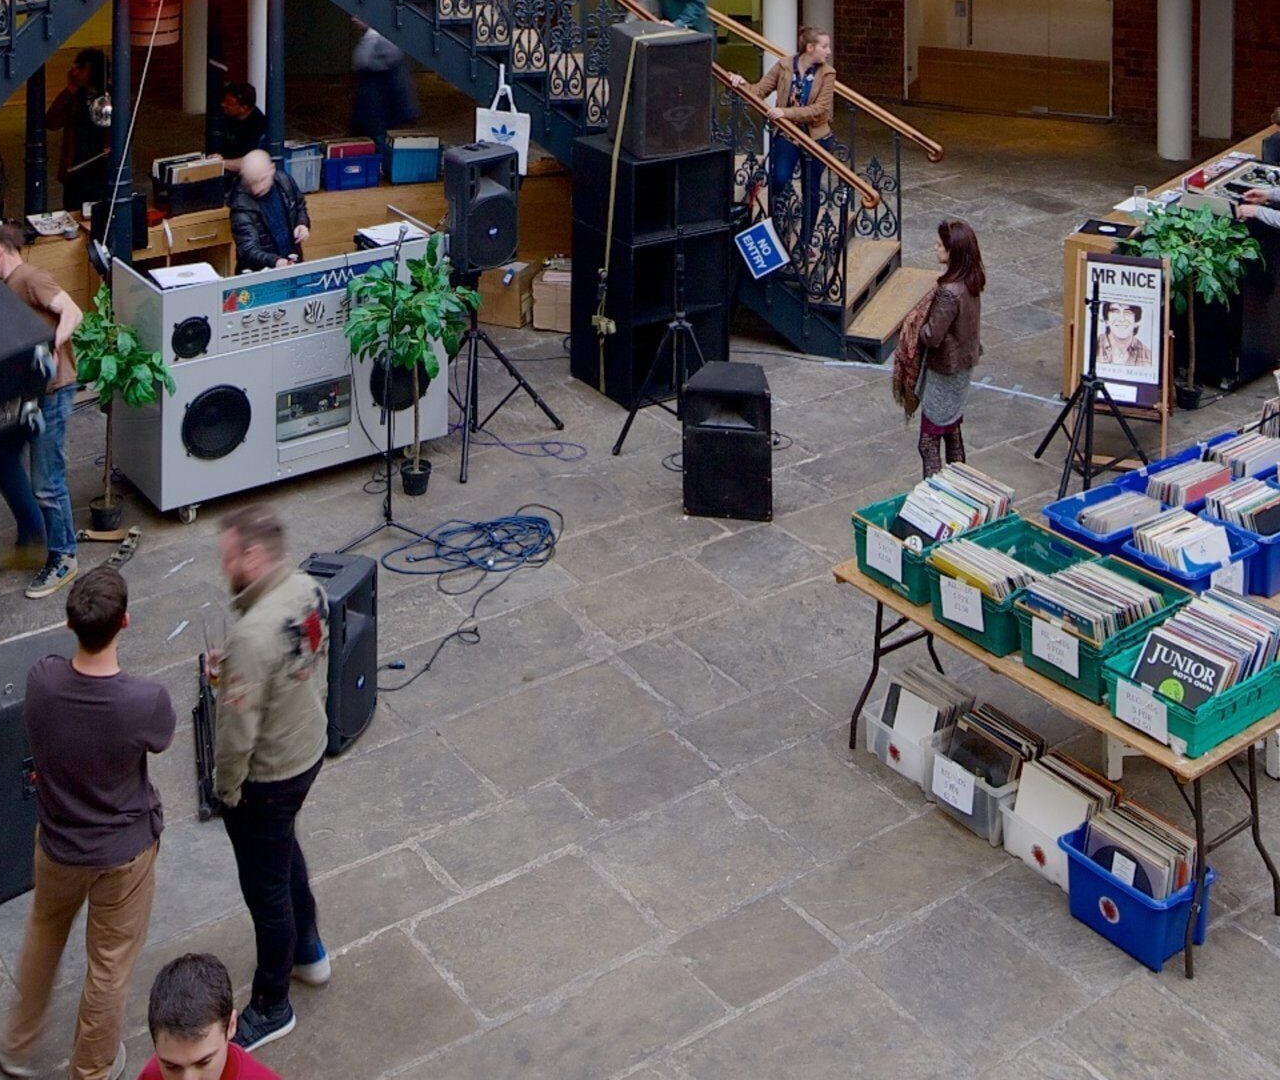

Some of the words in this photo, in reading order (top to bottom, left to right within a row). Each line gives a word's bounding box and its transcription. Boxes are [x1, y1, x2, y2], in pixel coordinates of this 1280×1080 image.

[1091, 267, 1117, 284] MR
[1121, 271, 1156, 289] NICE
[1147, 643, 1217, 686] JUNIOR
[1193, 680, 1213, 693] OWN
